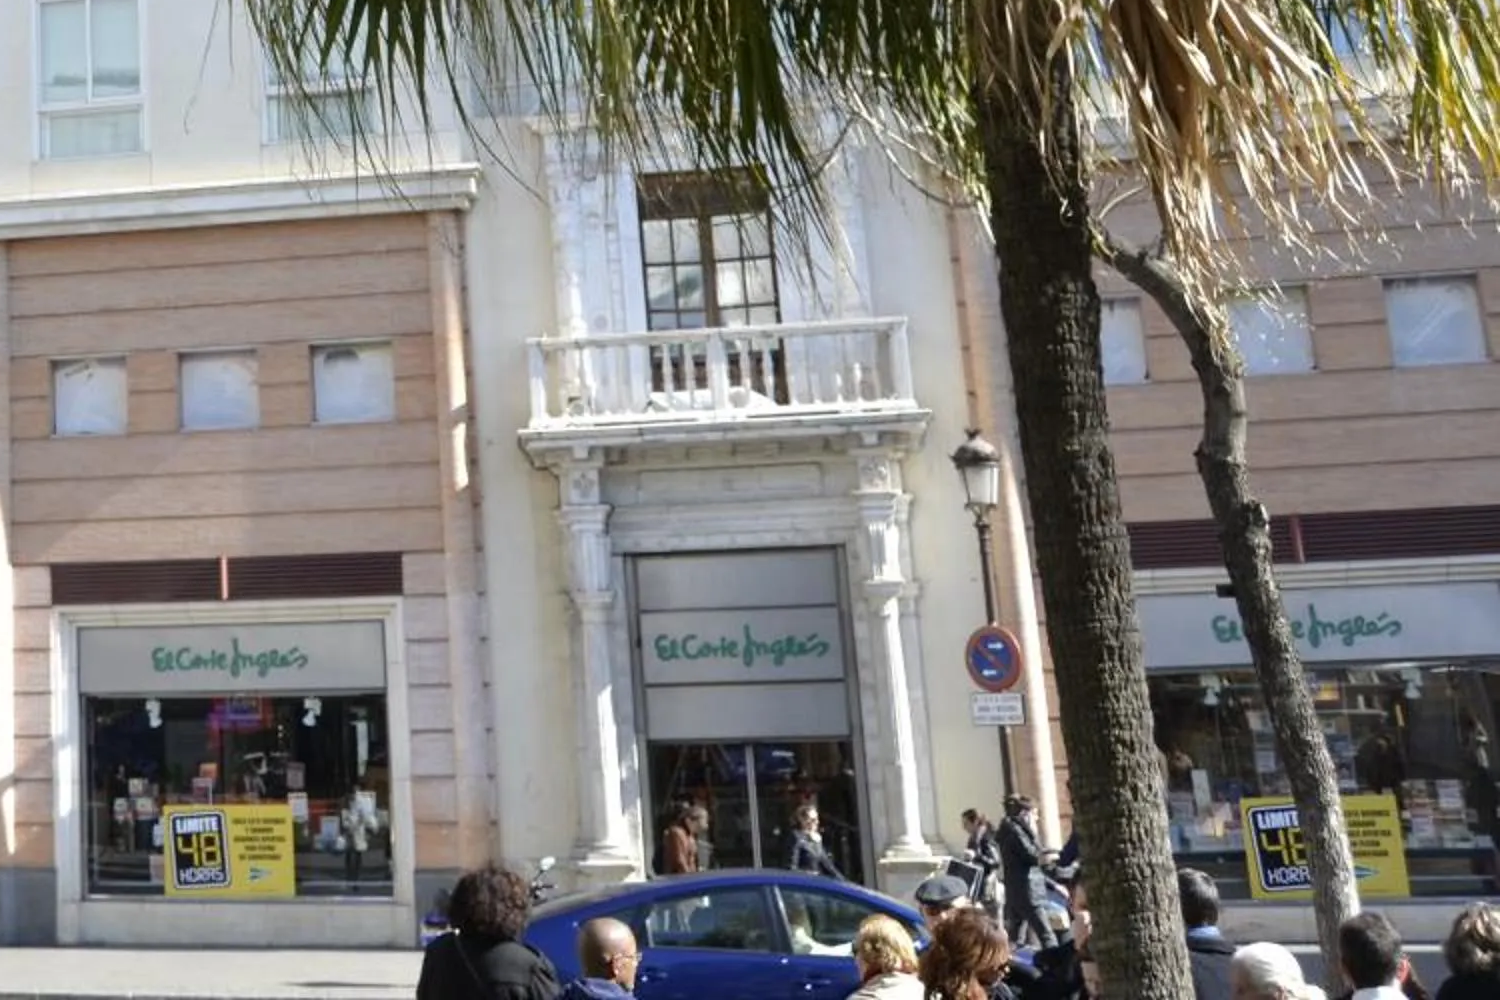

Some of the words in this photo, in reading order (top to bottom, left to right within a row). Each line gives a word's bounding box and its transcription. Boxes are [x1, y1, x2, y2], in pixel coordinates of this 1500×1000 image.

[1211, 615, 1242, 642] El
[1308, 603, 1402, 648] Inglés
[152, 647, 174, 672] El
[176, 647, 228, 671] Corte
[230, 637, 308, 678] Inglés
[654, 633, 680, 662] El
[681, 633, 740, 660] Corte
[743, 623, 831, 668] Inglés
[175, 816, 218, 834] LIMITE
[1256, 810, 1299, 829] LIMIT
[177, 832, 222, 867] 48
[180, 867, 224, 882] HORAS
[1268, 867, 1310, 885] HORA
